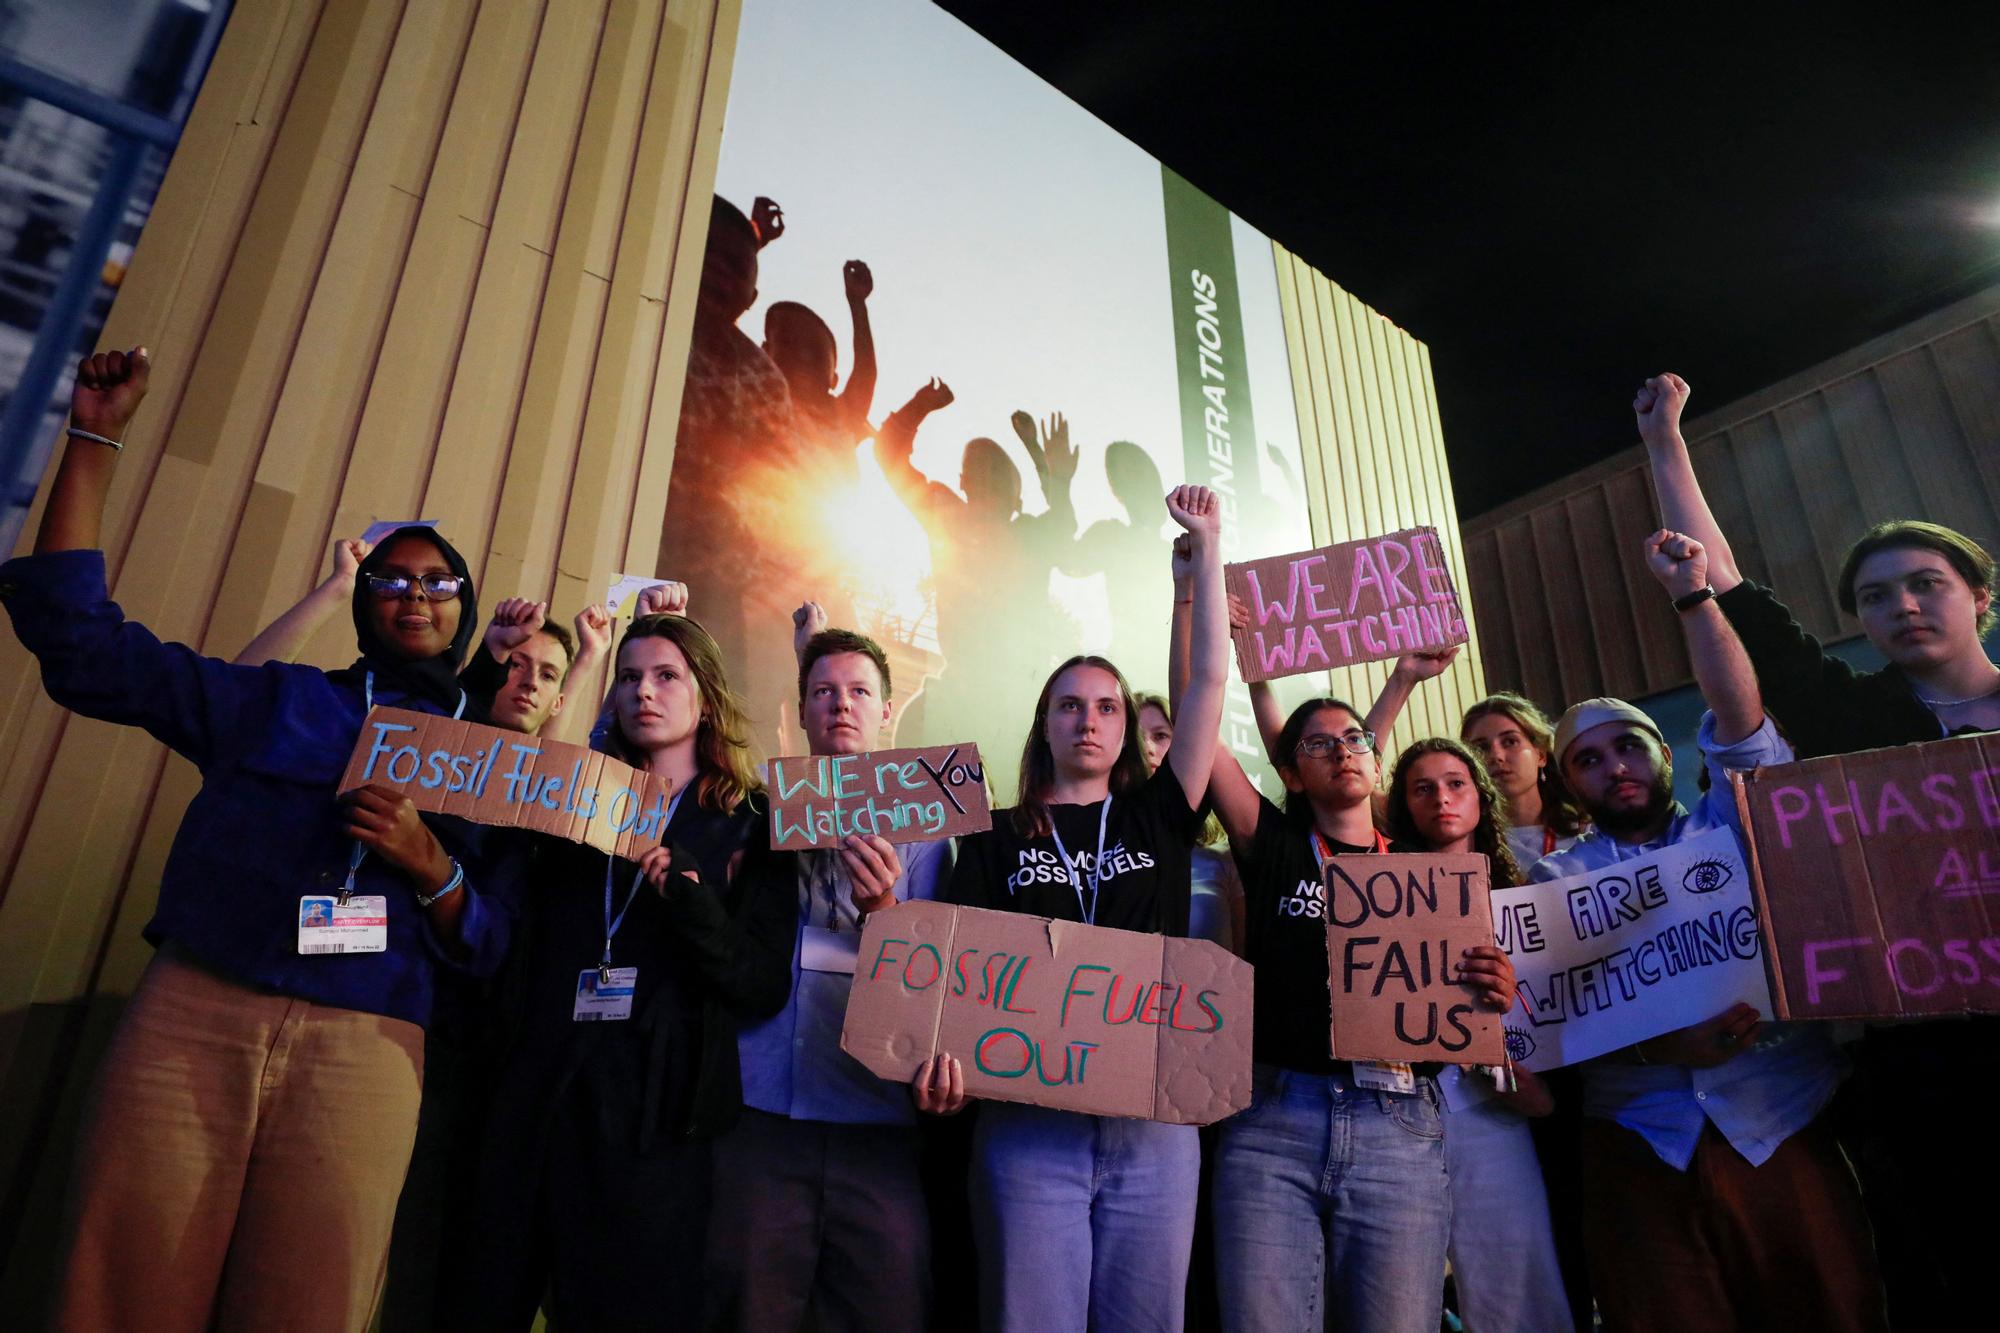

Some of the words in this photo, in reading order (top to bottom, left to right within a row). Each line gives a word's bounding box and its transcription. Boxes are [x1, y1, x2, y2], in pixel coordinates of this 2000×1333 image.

[1246, 555, 1341, 626] WE
[1349, 533, 1453, 614] ARE
[1254, 602, 1467, 673] WATCHING
[362, 722, 504, 799] Fossil
[503, 744, 600, 819] Fuels
[774, 797, 946, 845] Watching
[1770, 767, 2000, 849] PHASE
[1018, 848, 1058, 865] NO
[1326, 863, 1478, 928] DON'T
[1567, 865, 1668, 940] ARE
[870, 938, 1037, 1015] FOSSIL
[1060, 964, 1224, 1034] FUELS
[1343, 936, 1467, 997] FAIL
[1517, 905, 1759, 1028] WATCHING
[974, 1027, 1100, 1086] OUT
